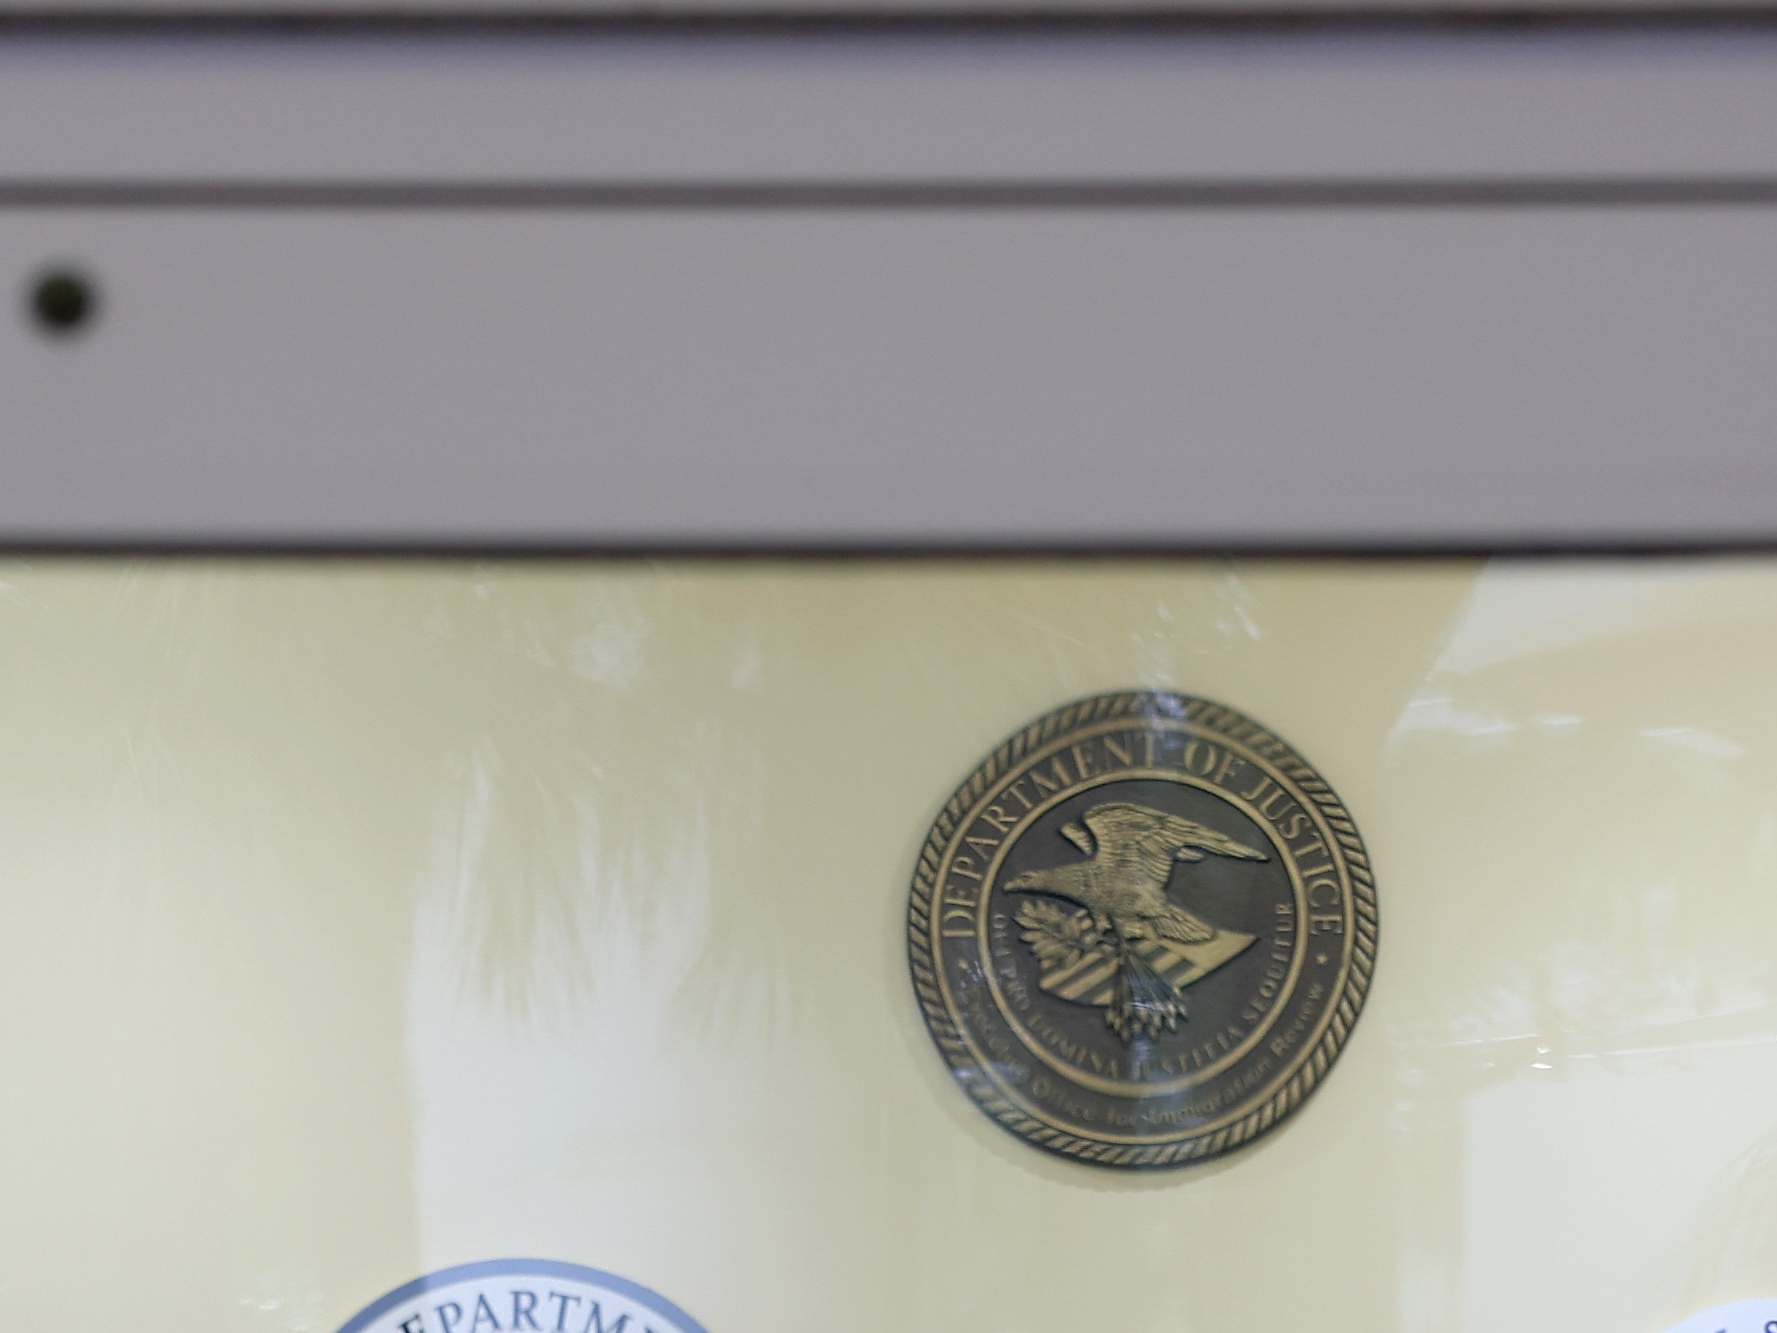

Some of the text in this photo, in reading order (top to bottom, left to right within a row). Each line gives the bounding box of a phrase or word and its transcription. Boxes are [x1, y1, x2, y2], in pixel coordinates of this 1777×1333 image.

[941, 730, 1343, 940] DEPARTMENT OF JUSTICE
